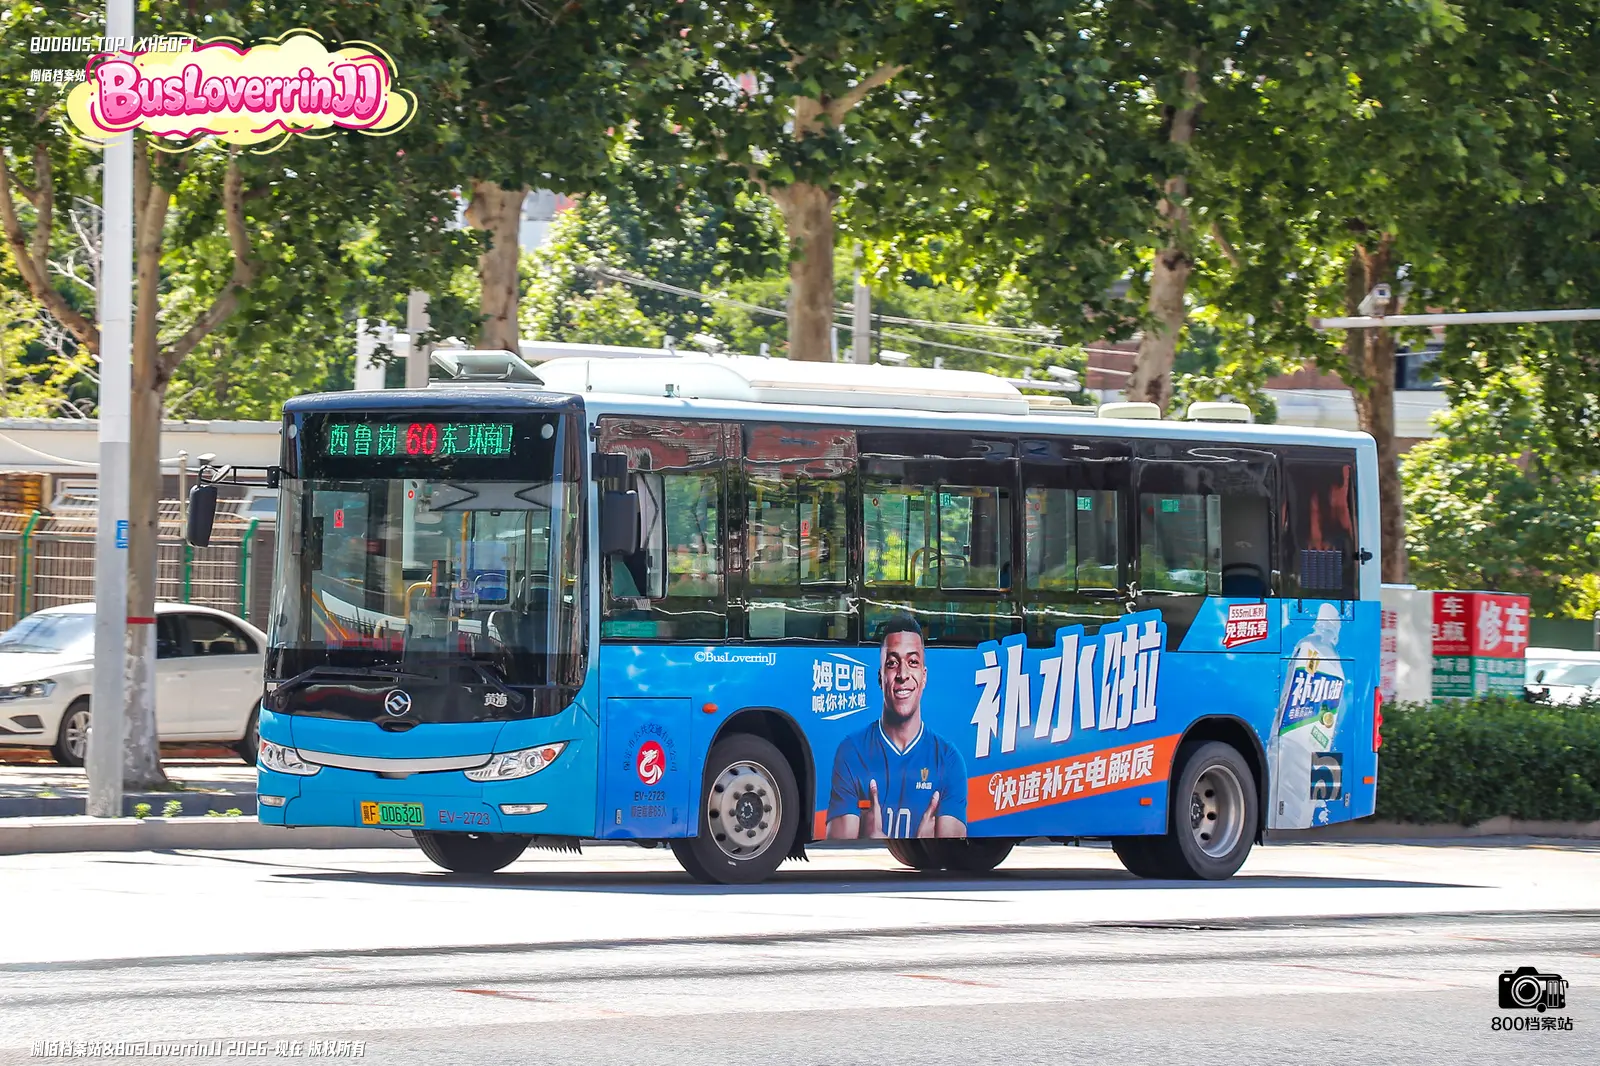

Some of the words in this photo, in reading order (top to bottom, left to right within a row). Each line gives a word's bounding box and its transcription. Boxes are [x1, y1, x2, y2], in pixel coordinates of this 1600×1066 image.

[330, 423, 398, 456] 西鲁岗
[406, 423, 438, 456] 60
[1223, 620, 1268, 644] 免费乐享
[1478, 600, 1529, 652] 修车
[812, 658, 867, 693] 姆巴佩
[970, 619, 1162, 758] 补水啦
[1290, 672, 1343, 707] 补水啦
[811, 692, 867, 714] 喊你补水啦
[993, 744, 1155, 811] 快速补充电解质
[634, 790, 666, 802] EV-2723
[439, 810, 491, 825] EV-2723
